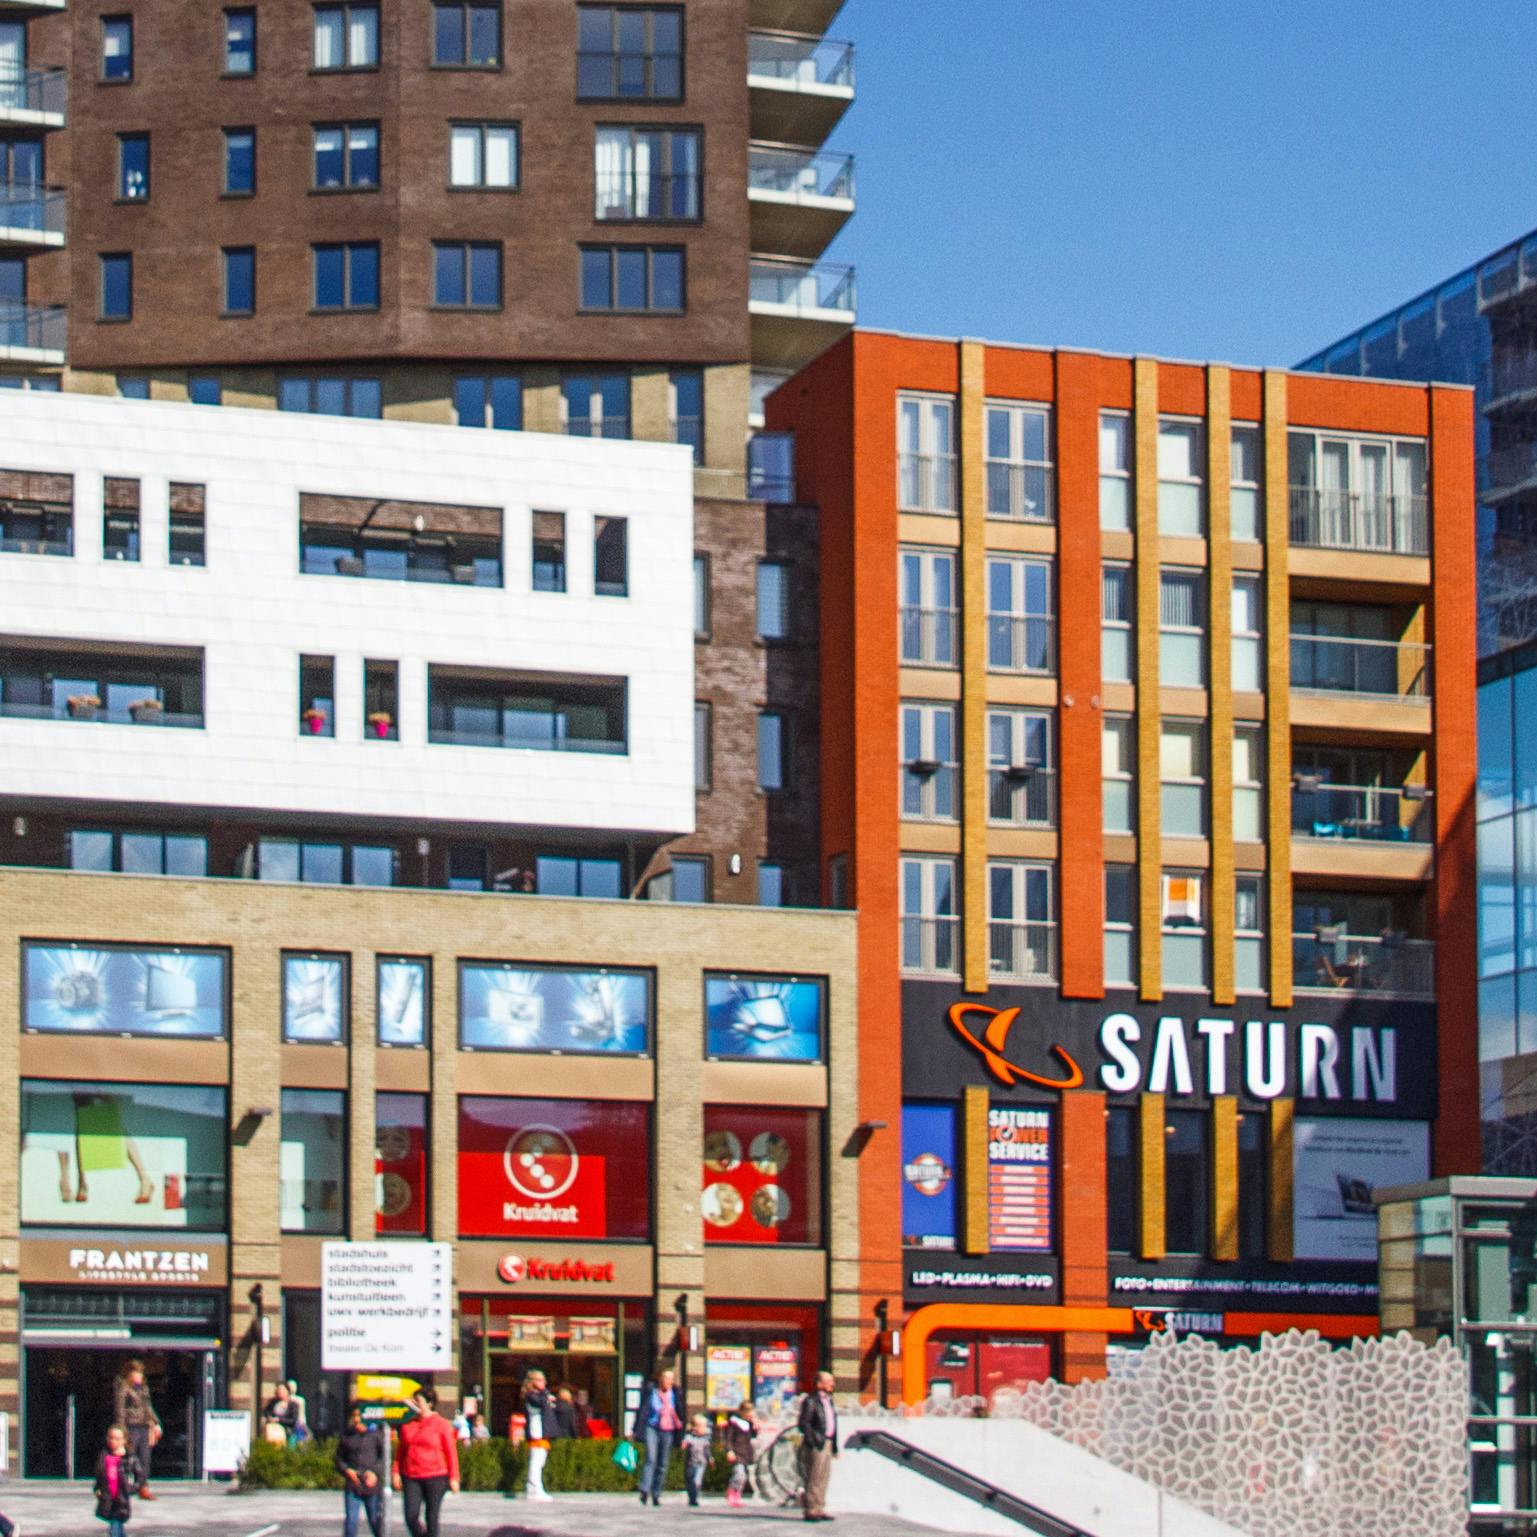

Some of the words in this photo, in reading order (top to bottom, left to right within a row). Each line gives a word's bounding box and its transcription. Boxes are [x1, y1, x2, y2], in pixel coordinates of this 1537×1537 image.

[1100, 1013, 1396, 1101] SATURN
[989, 1110, 1049, 1129] SATURN
[989, 1143, 1049, 1161] SERVICE
[503, 1202, 578, 1223] Kruidvat
[70, 1249, 209, 1271] FRANTZEN
[527, 1258, 615, 1282] Kruidvat
[1114, 1277, 1147, 1291] FOTO
